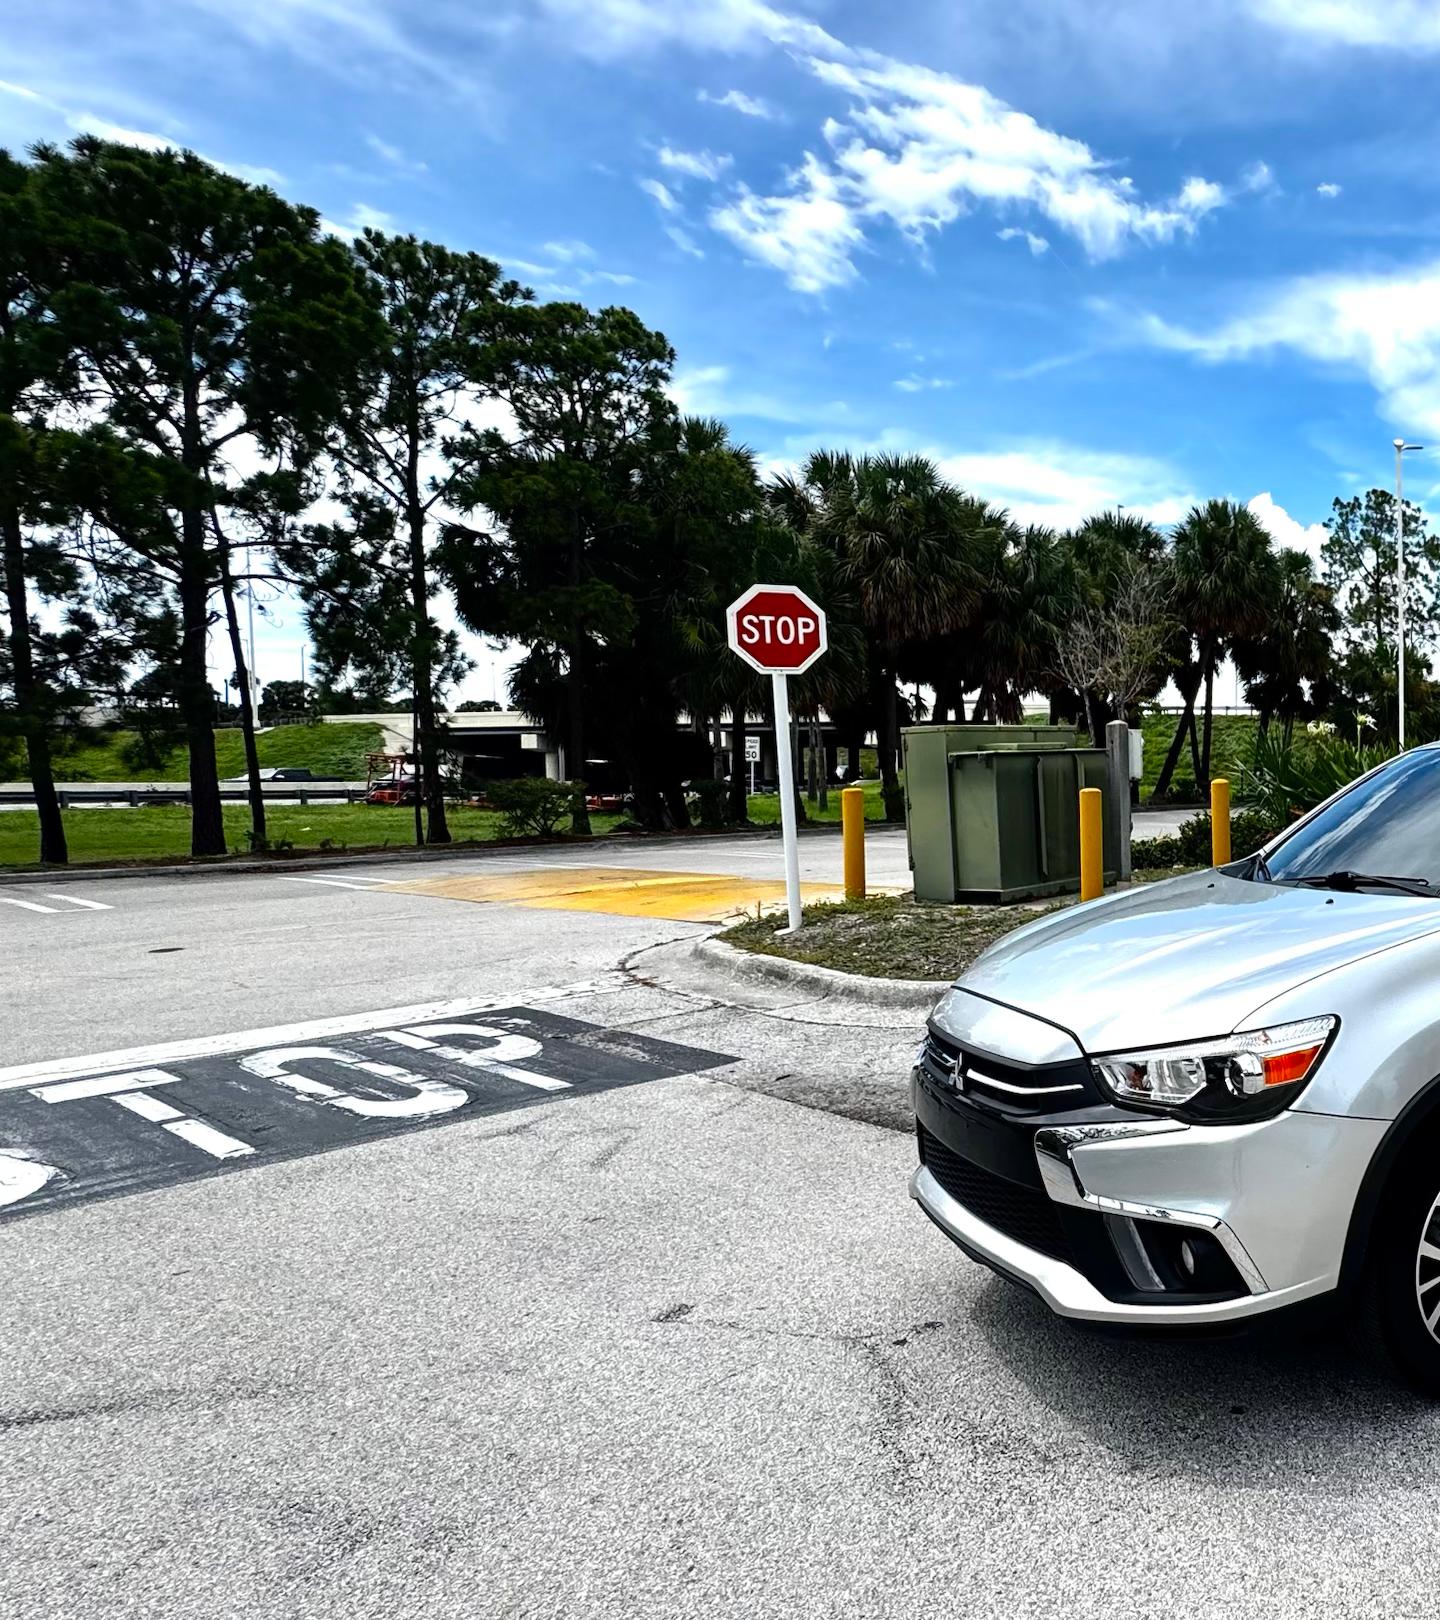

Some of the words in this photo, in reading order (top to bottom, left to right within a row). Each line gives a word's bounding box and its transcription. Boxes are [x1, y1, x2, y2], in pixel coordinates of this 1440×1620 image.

[741, 614, 816, 645] STOP
[745, 750, 757, 759] 50
[0, 1023, 574, 1203] TOP
